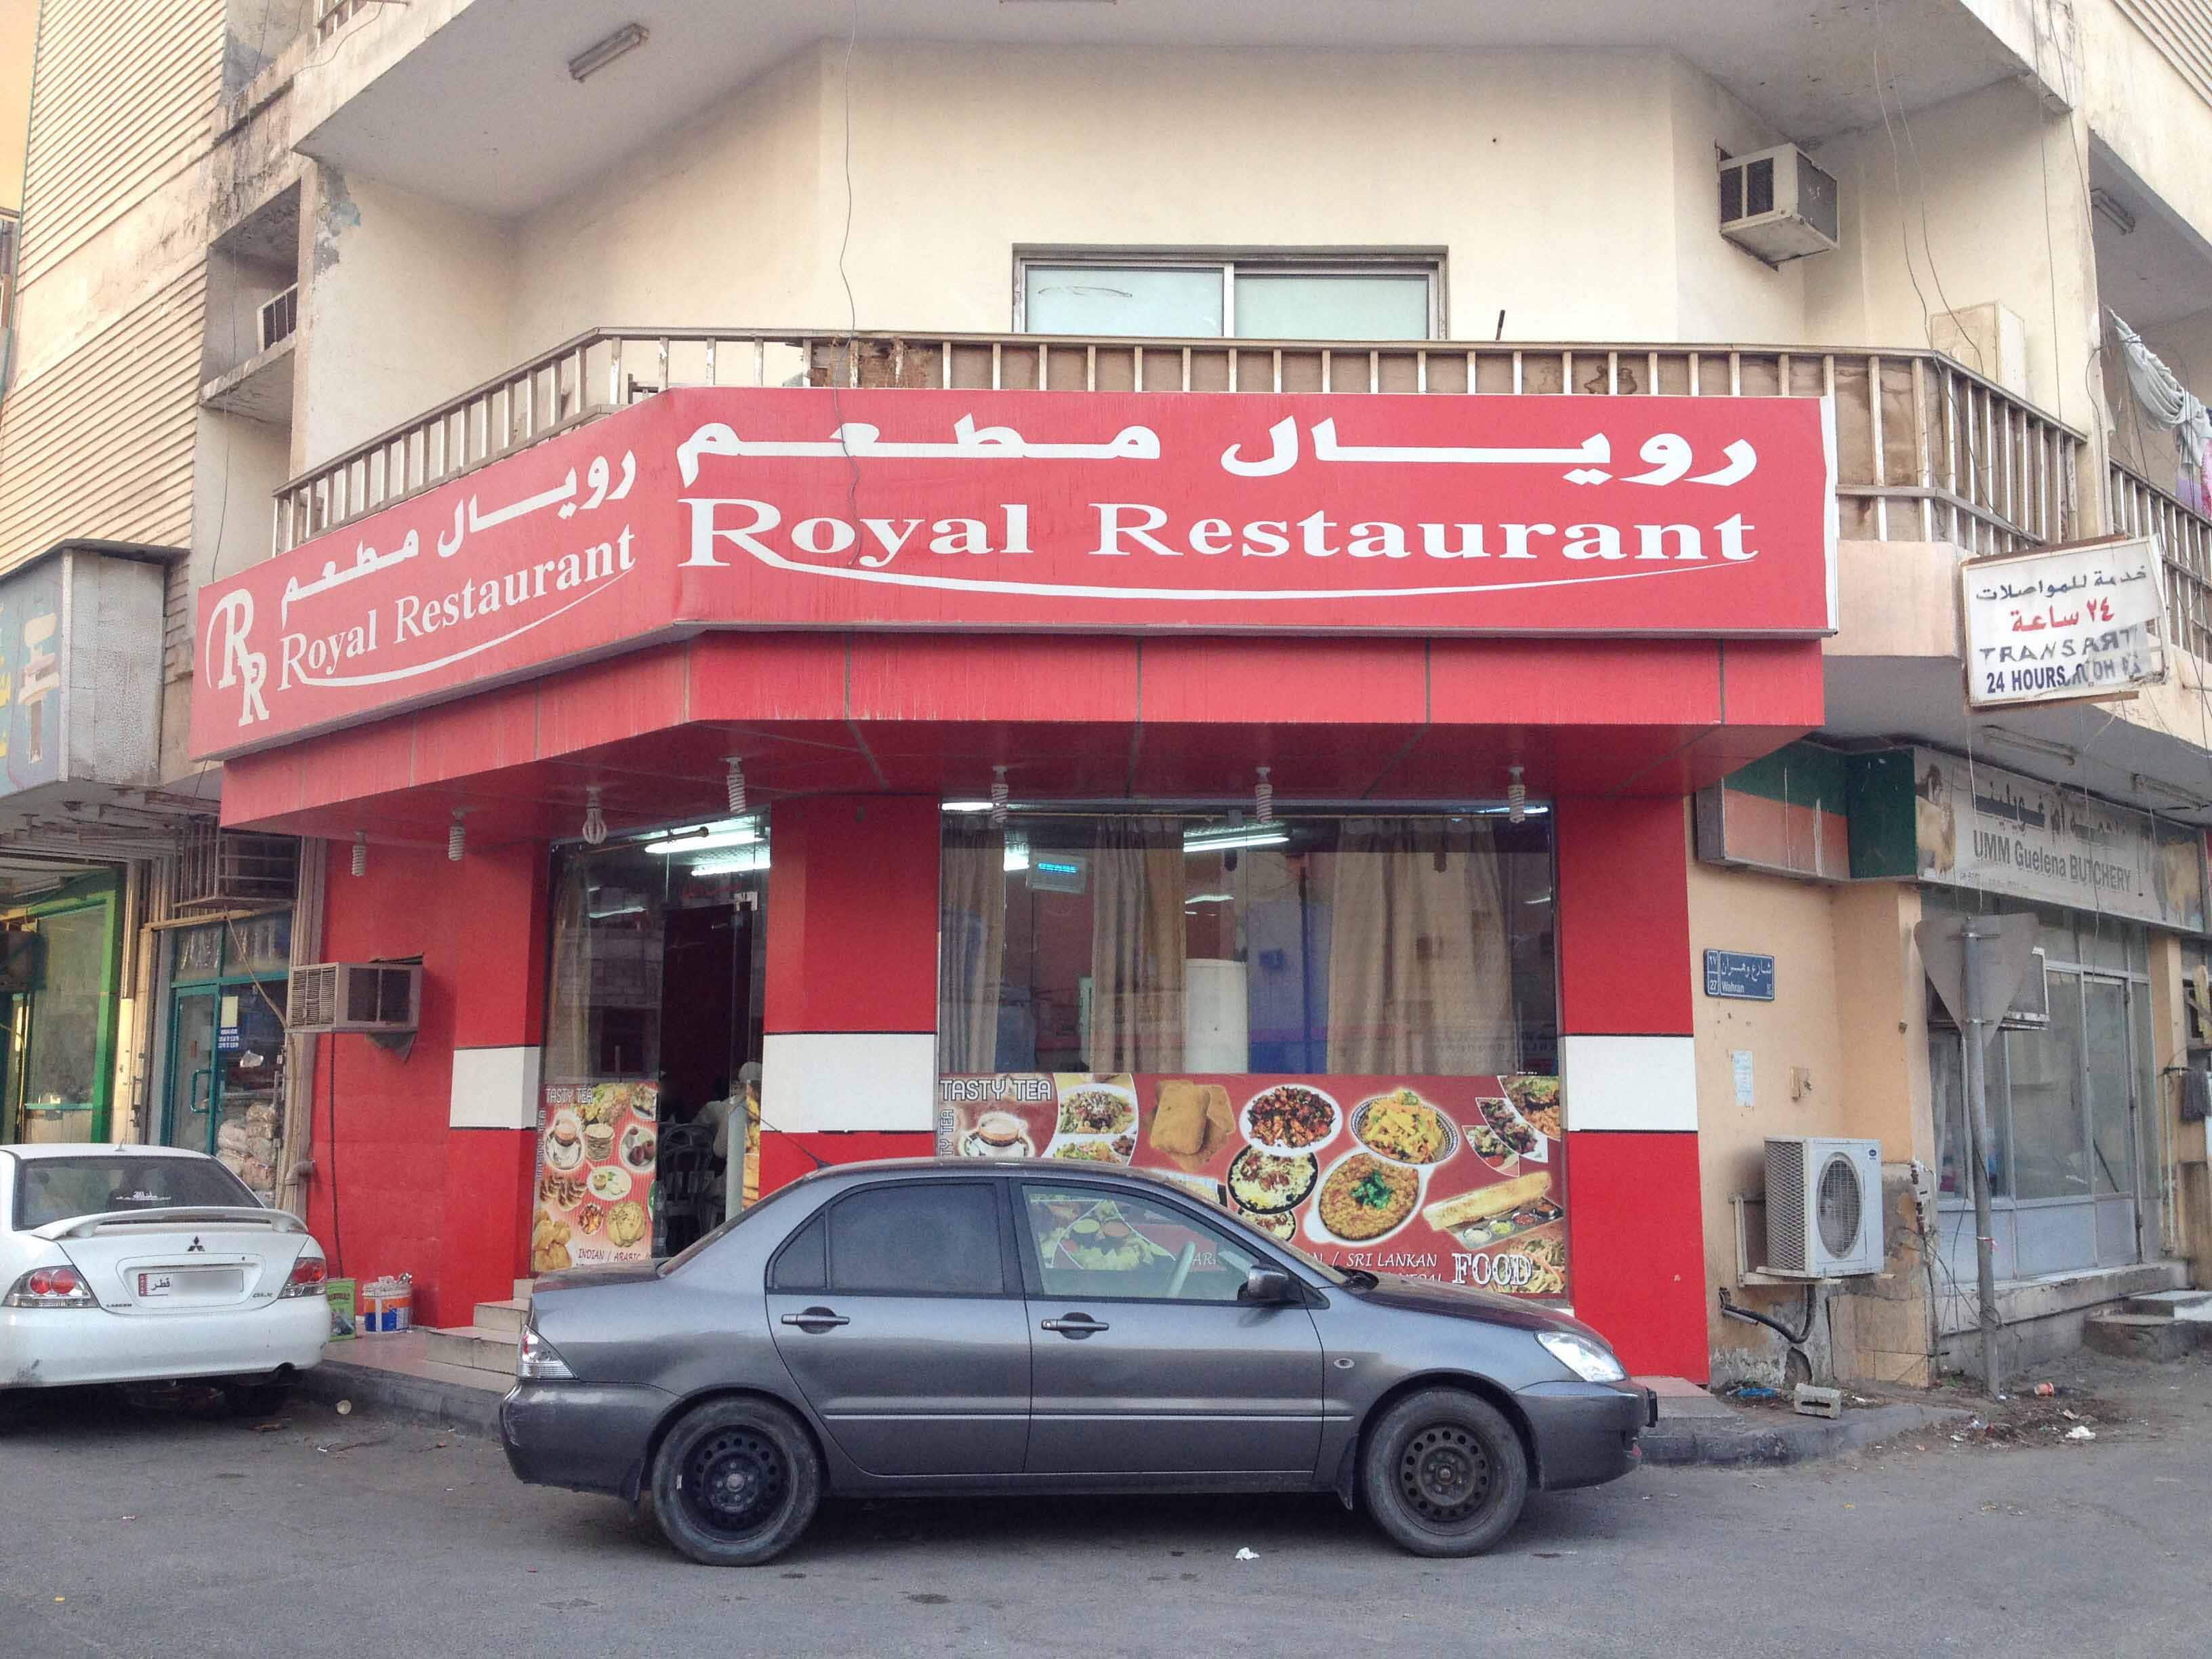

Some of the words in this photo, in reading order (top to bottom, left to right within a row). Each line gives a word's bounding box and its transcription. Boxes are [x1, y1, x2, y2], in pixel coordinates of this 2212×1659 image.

[676, 413, 1160, 488] مطعم
[1221, 415, 1757, 487] رويال
[282, 529, 419, 630] مطعم
[438, 449, 636, 558] رويال
[678, 498, 1031, 568] Royal
[1088, 504, 1759, 561] Restaurant
[2094, 565, 2147, 586] خدمة
[278, 610, 377, 691] Royal
[394, 523, 636, 644] Restaurant
[2010, 605, 2080, 632] ساعة
[1987, 672, 2006, 694] 24
[1973, 830, 2011, 864] UMM
[2015, 840, 2066, 878] Guelena
[2070, 854, 2131, 891] BUTCHERY
[546, 1087, 574, 1103] TASTY
[577, 1088, 593, 1104] TEA
[939, 1079, 1006, 1101] TASTY
[1013, 1079, 1052, 1101] TEA
[939, 1109, 954, 1135] TEA
[578, 1248, 605, 1260] INDIAN
[1347, 1253, 1372, 1267] SRI
[1378, 1253, 1437, 1268] LANKAN
[1452, 1253, 1534, 1286] FOOD
